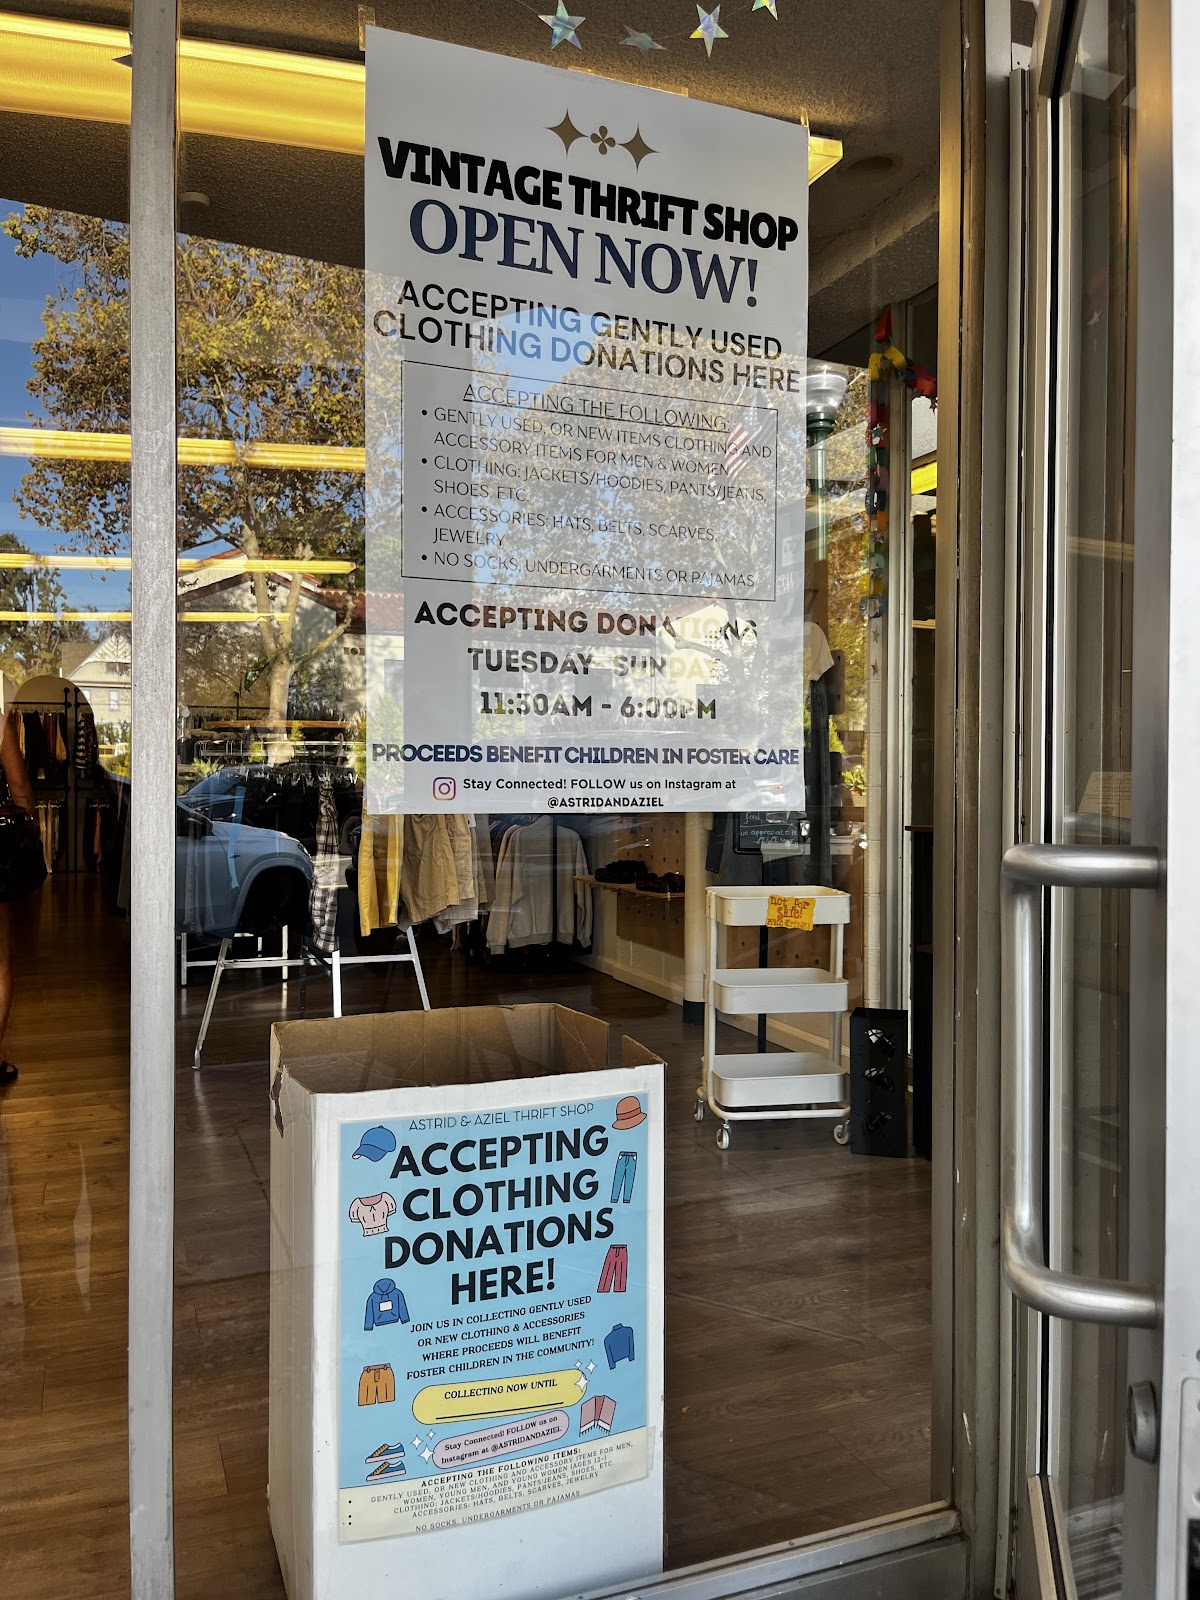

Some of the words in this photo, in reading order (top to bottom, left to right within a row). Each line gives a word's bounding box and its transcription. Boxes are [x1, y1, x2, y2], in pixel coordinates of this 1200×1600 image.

[377, 136, 562, 211] VINTAGE
[568, 175, 699, 236] THRIFT
[703, 203, 799, 251] SHOP
[409, 199, 584, 280] OPEN
[594, 232, 758, 308] NOW!
[397, 280, 582, 333] ACCEPTING
[590, 312, 703, 352] GENTLY
[710, 328, 782, 361] USED
[373, 310, 542, 361] CLOTHING
[550, 337, 725, 385] DONATIONS
[732, 364, 801, 393] HERE
[463, 384, 574, 413] ACCEPTING
[579, 398, 615, 418] THE
[620, 403, 730, 431] FOLLOWING:
[434, 407, 496, 428] GENTLY
[550, 422, 573, 437] OR
[577, 425, 613, 441] NEW
[617, 430, 661, 448] ITEMS
[664, 435, 738, 455] CLOTHING
[741, 445, 772, 459] AND
[433, 432, 532, 455] ACCESSORY
[536, 443, 582, 462] ITEMS
[586, 449, 616, 465] FOR
[620, 453, 654, 469] MEN
[657, 457, 667, 470] &
[671, 459, 729, 476] WOMEN
[434, 455, 521, 478] CLOTHING:
[432, 527, 505, 546] JEWELRY
[552, 515, 594, 532] HATS,
[598, 519, 645, 537] BELTS,
[434, 552, 459, 566] NO
[525, 559, 662, 582] UNDERGARMENTS
[666, 569, 687, 583] OR
[691, 571, 755, 587] PAJAMAS
[414, 601, 588, 633] ACCEPTING
[467, 647, 592, 675] TUESDAY
[613, 655, 721, 680] SUNDAY
[620, 696, 717, 719] 6:00PM
[372, 743, 483, 763] PROCEEDS
[486, 745, 562, 763] BENEFIT
[564, 746, 659, 764] CHILDREN
[661, 747, 683, 764] IN
[687, 748, 751, 765] FOSTER
[753, 749, 800, 765] CARE
[463, 778, 492, 791] Stay
[495, 778, 566, 789] Connected!
[570, 779, 626, 789] FOLLOW
[629, 781, 643, 789] us
[646, 781, 661, 789] on
[664, 779, 722, 791] Instagram
[725, 779, 736, 789] at
[547, 797, 664, 809] @ASTRIDANDAZIEL
[409, 1115, 456, 1131] ASTRID
[460, 1115, 471, 1127] &
[474, 1112, 510, 1126] AZIEL
[514, 1106, 557, 1121] THRIFT
[560, 1102, 594, 1117] SHOP
[390, 1125, 609, 1179] ACCEPTING
[402, 1168, 599, 1221] CLOTHING
[384, 1207, 614, 1270] DONATIONS
[451, 1257, 555, 1305] HERE!
[410, 1321, 433, 1333] JOIN
[436, 1319, 450, 1329] US
[452, 1317, 463, 1326] IN
[466, 1307, 526, 1323] COLLECTING
[529, 1301, 565, 1314] GENTLY
[567, 1295, 592, 1307] USED
[417, 1338, 432, 1347] OR
[435, 1333, 458, 1345] NEW
[461, 1326, 510, 1341] CLOTHING
[512, 1324, 520, 1332] &
[522, 1311, 585, 1331] ACCESSORIES
[406, 1366, 445, 1380] FOSTER
[449, 1357, 500, 1373] CHILDREN
[502, 1355, 513, 1364] IN
[515, 1351, 534, 1361] THE
[537, 1338, 595, 1357] COMMUNITY!
[422, 1349, 459, 1362] WHERE
[462, 1340, 513, 1356] PROCEEDS
[516, 1335, 540, 1346] WILL
[542, 1326, 582, 1341] BENEFIT
[444, 1386, 504, 1399] COLLECTING
[506, 1382, 529, 1393] NOW
[531, 1379, 558, 1389] UNTIL
[441, 1449, 479, 1464] Instagram
[490, 1425, 562, 1453] @ASTRIDANDAZIEL
[444, 1441, 462, 1451] Stay
[464, 1431, 505, 1446] Connected!
[506, 1421, 537, 1435] FOLLOW
[371, 1492, 403, 1503] GENTLY
[449, 1481, 466, 1490] NEW
[469, 1473, 508, 1486] CLOTHING
[511, 1469, 527, 1477] AND
[530, 1458, 574, 1475] ACCESSORY
[576, 1451, 597, 1461] ITEMS
[599, 1447, 614, 1455] FOR
[420, 1471, 473, 1487] ACCEPTING
[476, 1467, 495, 1477] THE
[498, 1455, 549, 1473] FOLLOWING
[553, 1448, 581, 1460] ITEMS:
[439, 1489, 468, 1499] YOUNG
[493, 1480, 509, 1490] AND
[511, 1473, 538, 1485] YOUNG
[541, 1465, 568, 1477] WOMEN
[566, 1471, 599, 1484] JEWELRY
[462, 1503, 531, 1524] UNDERGARMENTS
[533, 1499, 544, 1507] OR
[547, 1490, 581, 1504] PAJAMAS
